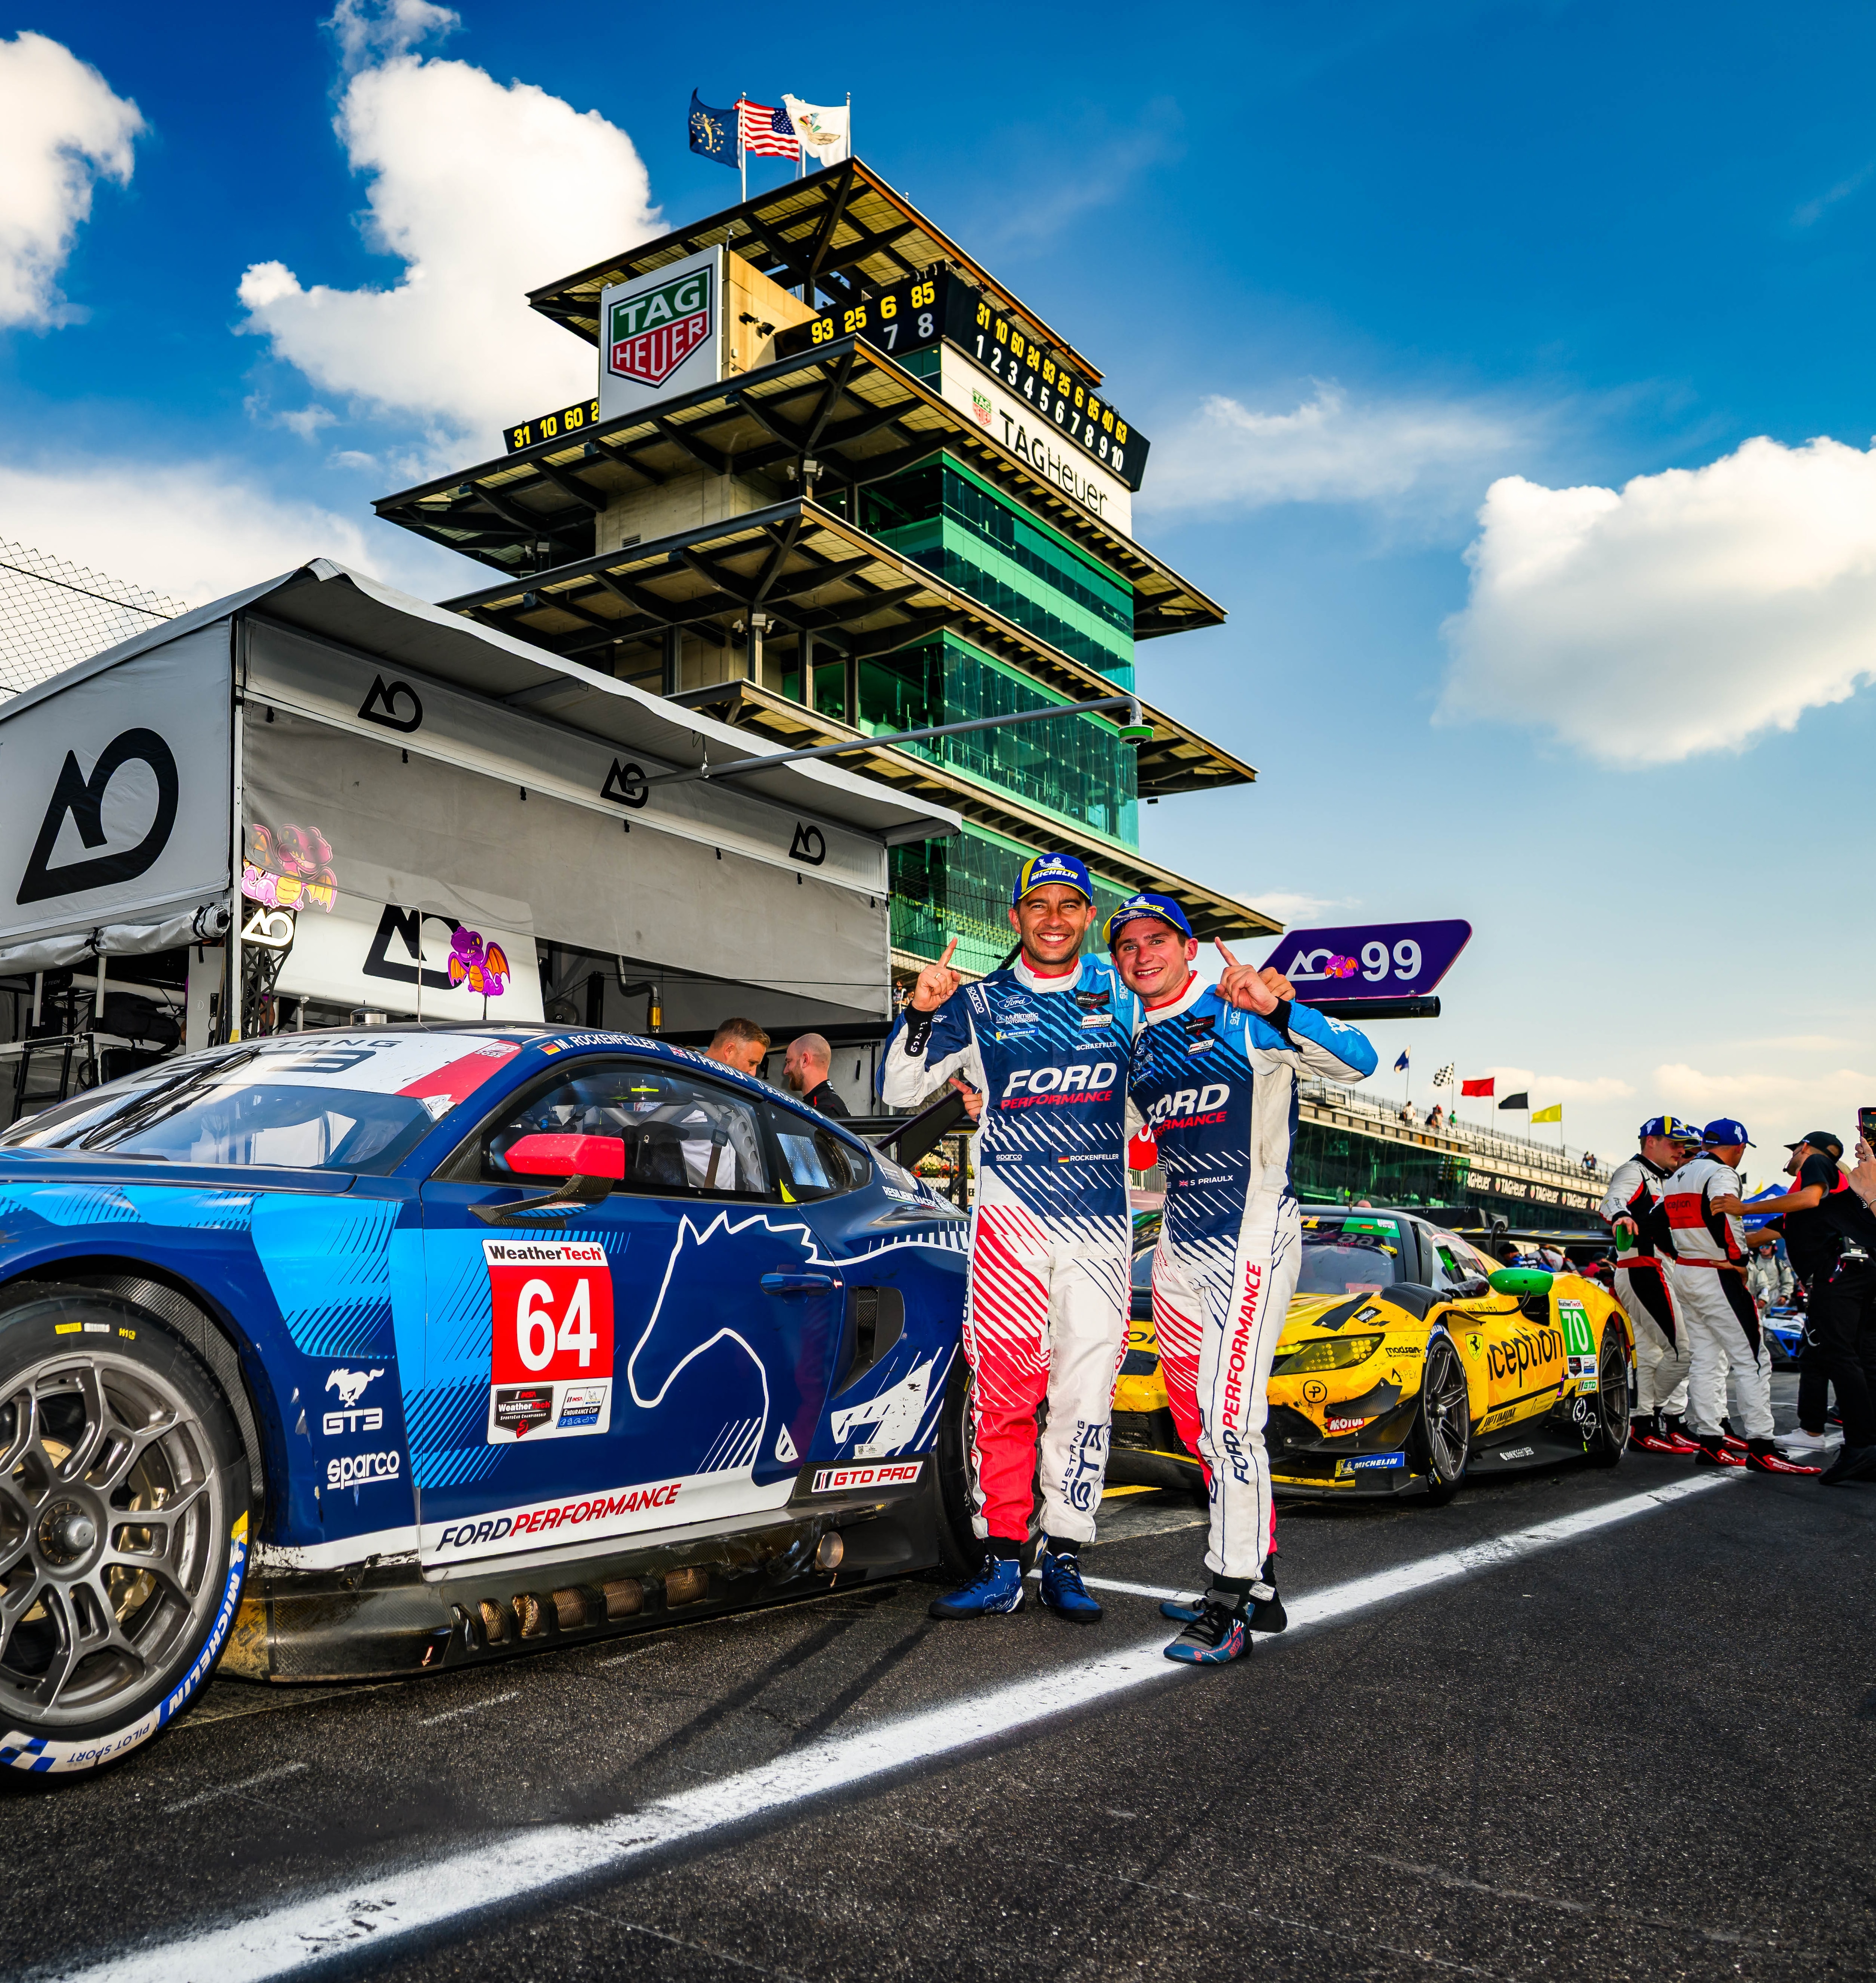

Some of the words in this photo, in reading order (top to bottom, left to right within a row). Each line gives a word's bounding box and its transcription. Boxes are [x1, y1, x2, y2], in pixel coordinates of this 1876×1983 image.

[619, 280, 700, 333] TAG
[811, 318, 833, 344] 93
[844, 306, 867, 333] 25
[881, 295, 896, 319] 6
[911, 281, 935, 309] 85
[883, 323, 898, 350] 7
[918, 313, 933, 338] 8
[616, 317, 704, 376] HEUER
[977, 302, 990, 331] 31
[996, 318, 1007, 345] 10
[1011, 331, 1024, 358] 60
[1027, 345, 1039, 372] 24
[1044, 359, 1055, 385] 93
[1058, 372, 1070, 398] 25
[1075, 386, 1083, 409] 6
[1088, 397, 1099, 421] 85
[1102, 410, 1113, 434] 40
[1116, 421, 1126, 444] 63
[976, 335, 984, 359] 1
[991, 347, 1000, 374] 2
[1008, 361, 1017, 386] 3
[1024, 376, 1033, 400] 4
[1040, 390, 1049, 411] 5
[1055, 400, 1064, 424] 6
[1072, 411, 1080, 435] 7
[1085, 424, 1093, 448] 8
[1099, 436, 1107, 459] 9
[1112, 445, 1123, 472] 10
[514, 426, 530, 447] 31
[540, 417, 557, 438] 10
[565, 407, 583, 430] 60
[1031, 870, 1078, 882] MICHELIN
[1361, 940, 1421, 981] 99
[966, 986, 985, 1014] sparco
[1004, 997, 1025, 1008] Ford
[1006, 1012, 1039, 1020] Multimatic
[556, 1038, 574, 1051] M.
[568, 1034, 660, 1051] ROCKENFELLER
[1076, 1042, 1116, 1051] SCHAEFFLER
[685, 1051, 700, 1063] S.
[700, 1055, 748, 1082] PRIAULX
[1003, 1063, 1117, 1097] FORD
[1001, 1090, 1113, 1110] PERFORMANCE
[1198, 1175, 1233, 1184] PRIAULX
[882, 1186, 915, 1202] RESILIENT
[914, 1195, 940, 1208] RACERS
[489, 1246, 601, 1260] WeatherTech
[517, 1278, 597, 1371] 64
[1562, 1311, 1588, 1352] 70
[1399, 1370, 1417, 1379] APEX
[499, 1401, 550, 1412] WeatherTech
[1484, 1408, 1517, 1426] OPTIMUM
[323, 1407, 382, 1435] GT3
[1330, 1418, 1363, 1430] MOTUL
[327, 1450, 399, 1490] sparco
[834, 1470, 873, 1485] GTD
[877, 1466, 917, 1482] PRO
[1060, 1420, 1085, 1505] MUSTANG
[1071, 1424, 1104, 1511] GT3
[1354, 1458, 1397, 1468] MICHELIN
[169, 1572, 240, 1716] MICHELIN
[114, 1723, 150, 1751] PILOT
[67, 1744, 111, 1763] SPORT
